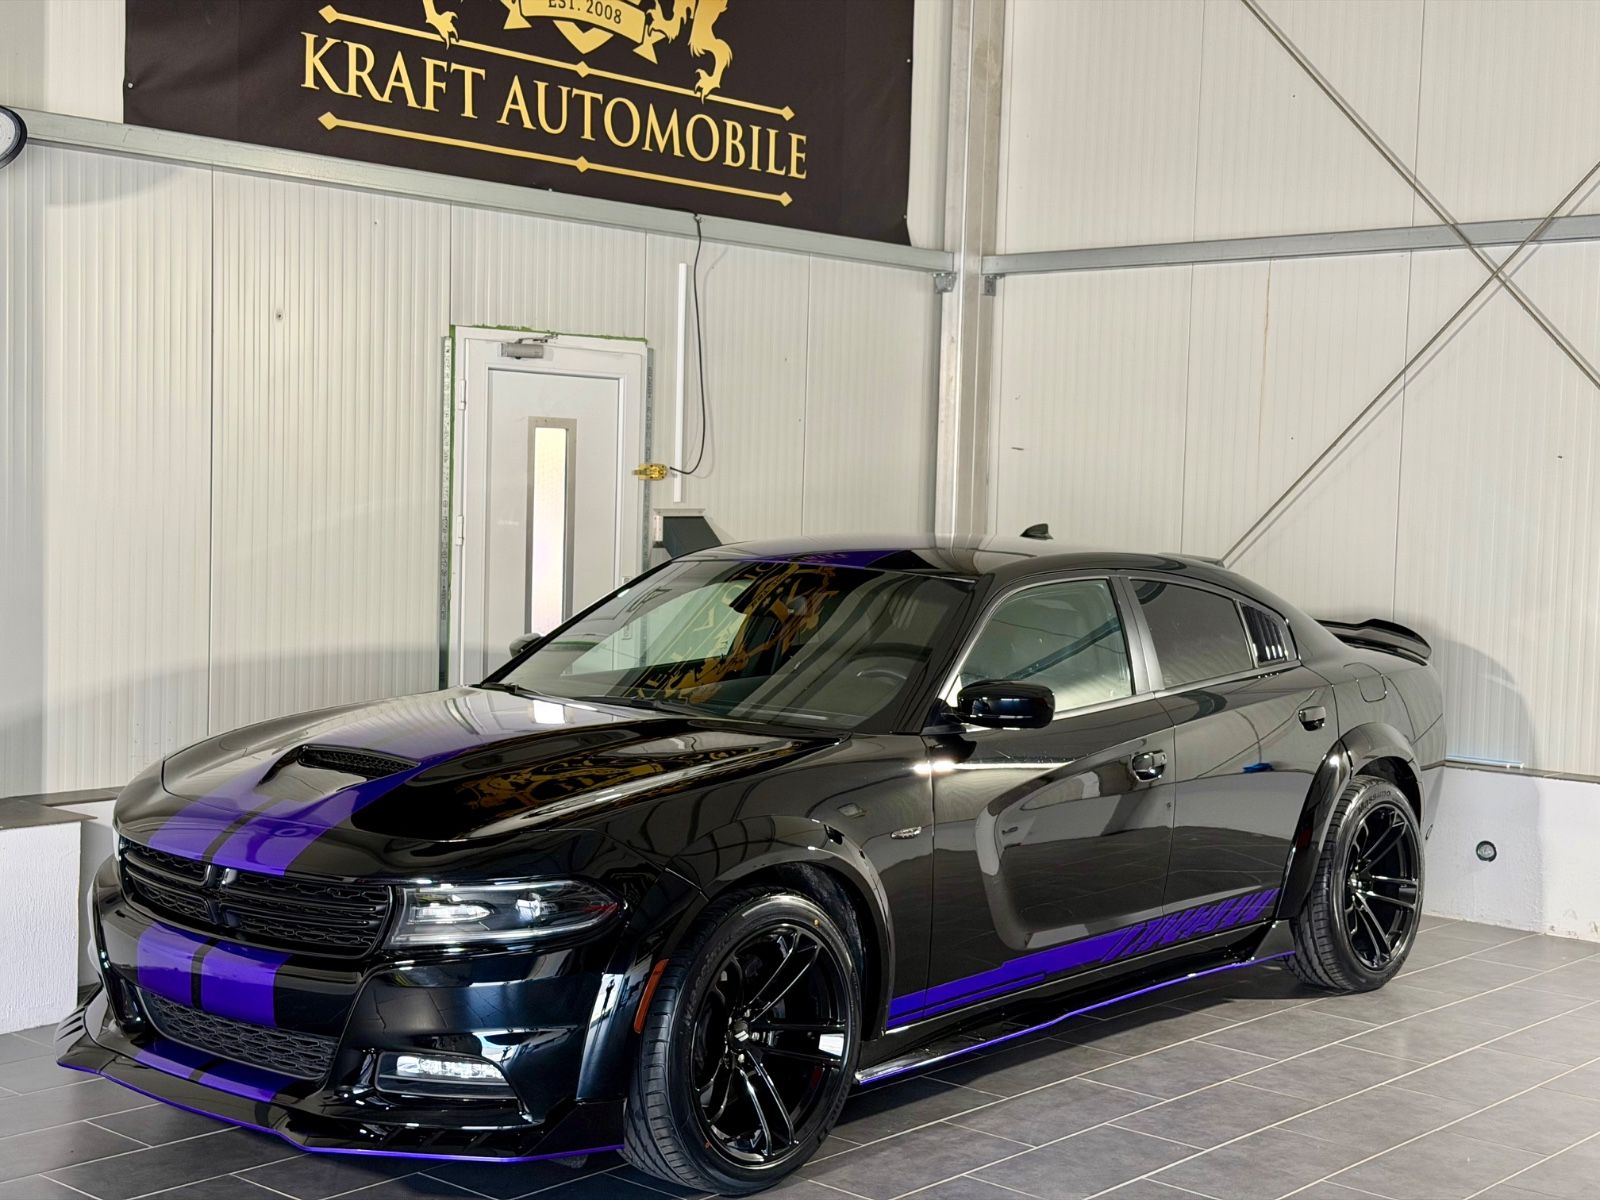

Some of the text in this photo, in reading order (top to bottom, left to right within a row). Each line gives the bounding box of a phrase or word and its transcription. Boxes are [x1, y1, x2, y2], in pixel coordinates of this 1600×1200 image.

[586, 0, 622, 24] 2008
[300, 31, 807, 180] KRAFT AUTOMOBILE
